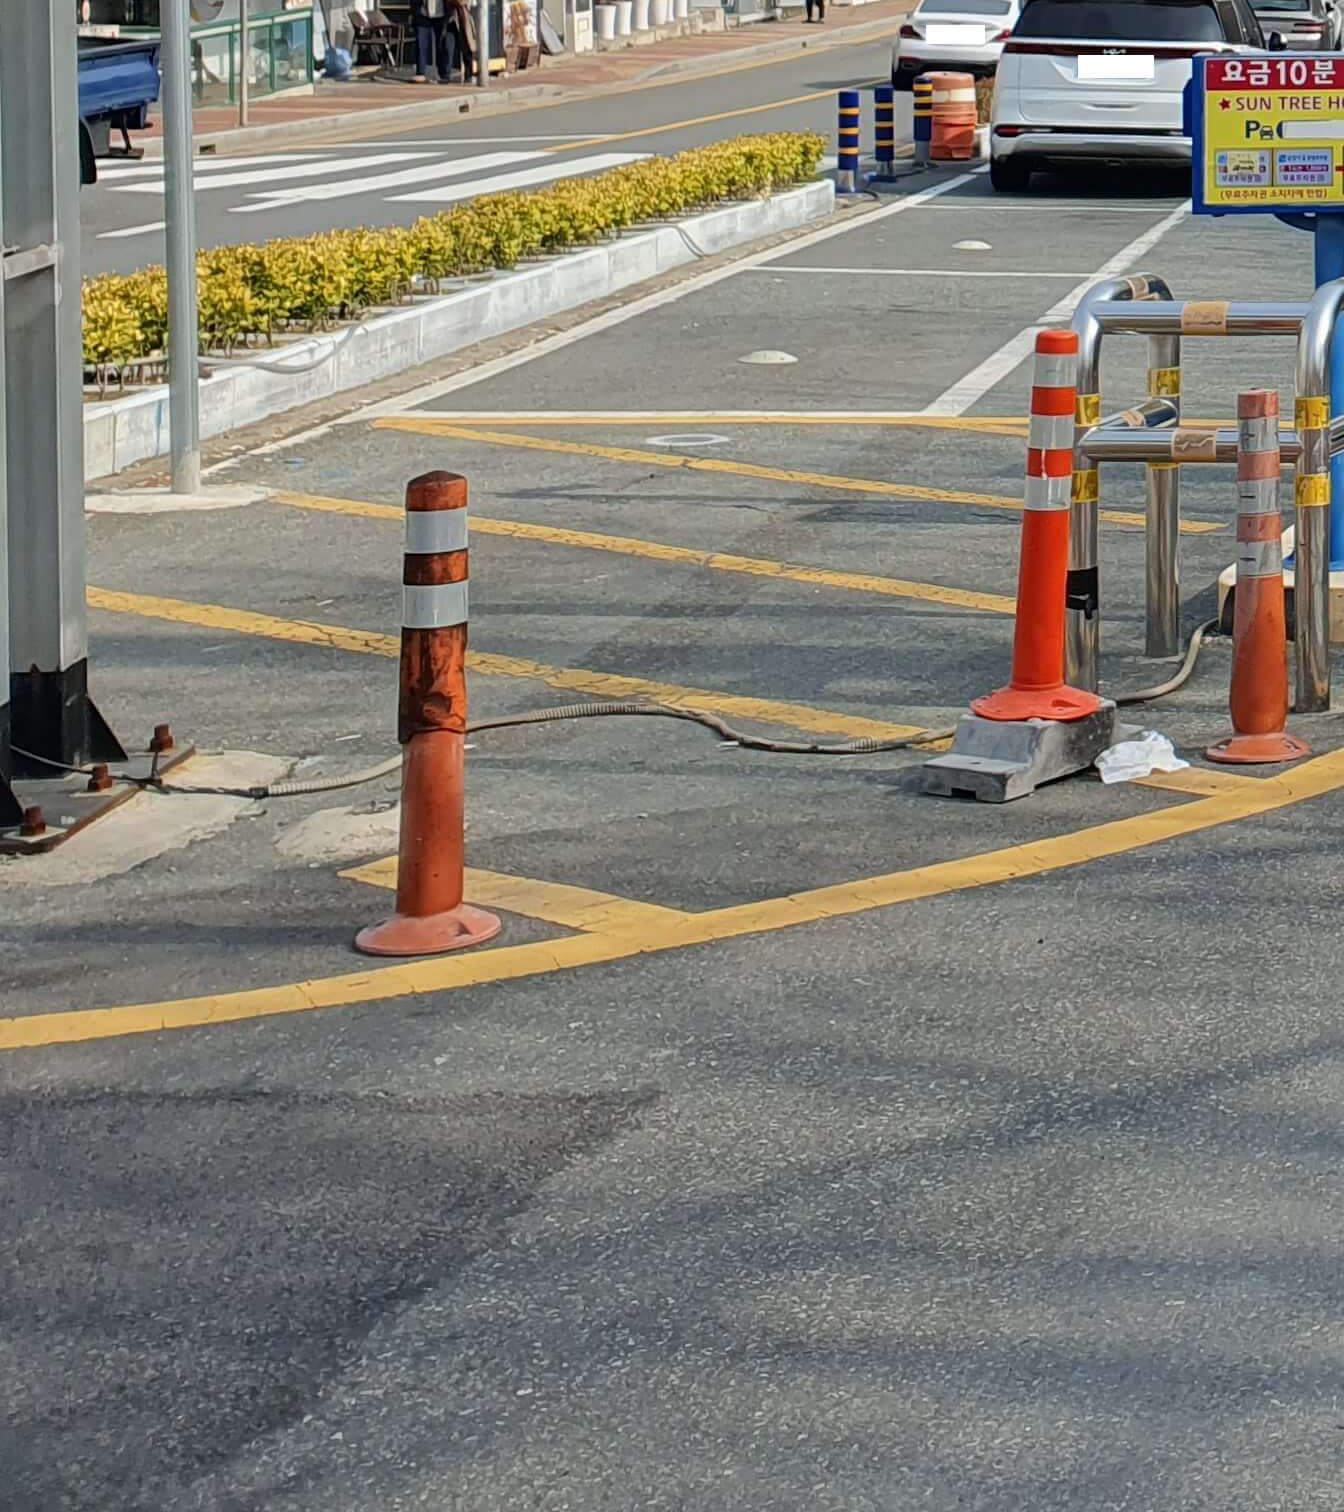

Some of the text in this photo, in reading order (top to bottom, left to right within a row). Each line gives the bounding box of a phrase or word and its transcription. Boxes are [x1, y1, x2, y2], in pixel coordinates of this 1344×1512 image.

[1236, 97, 1272, 111] SUN
[1278, 96, 1322, 110] TREE
[1245, 120, 1260, 139] P
